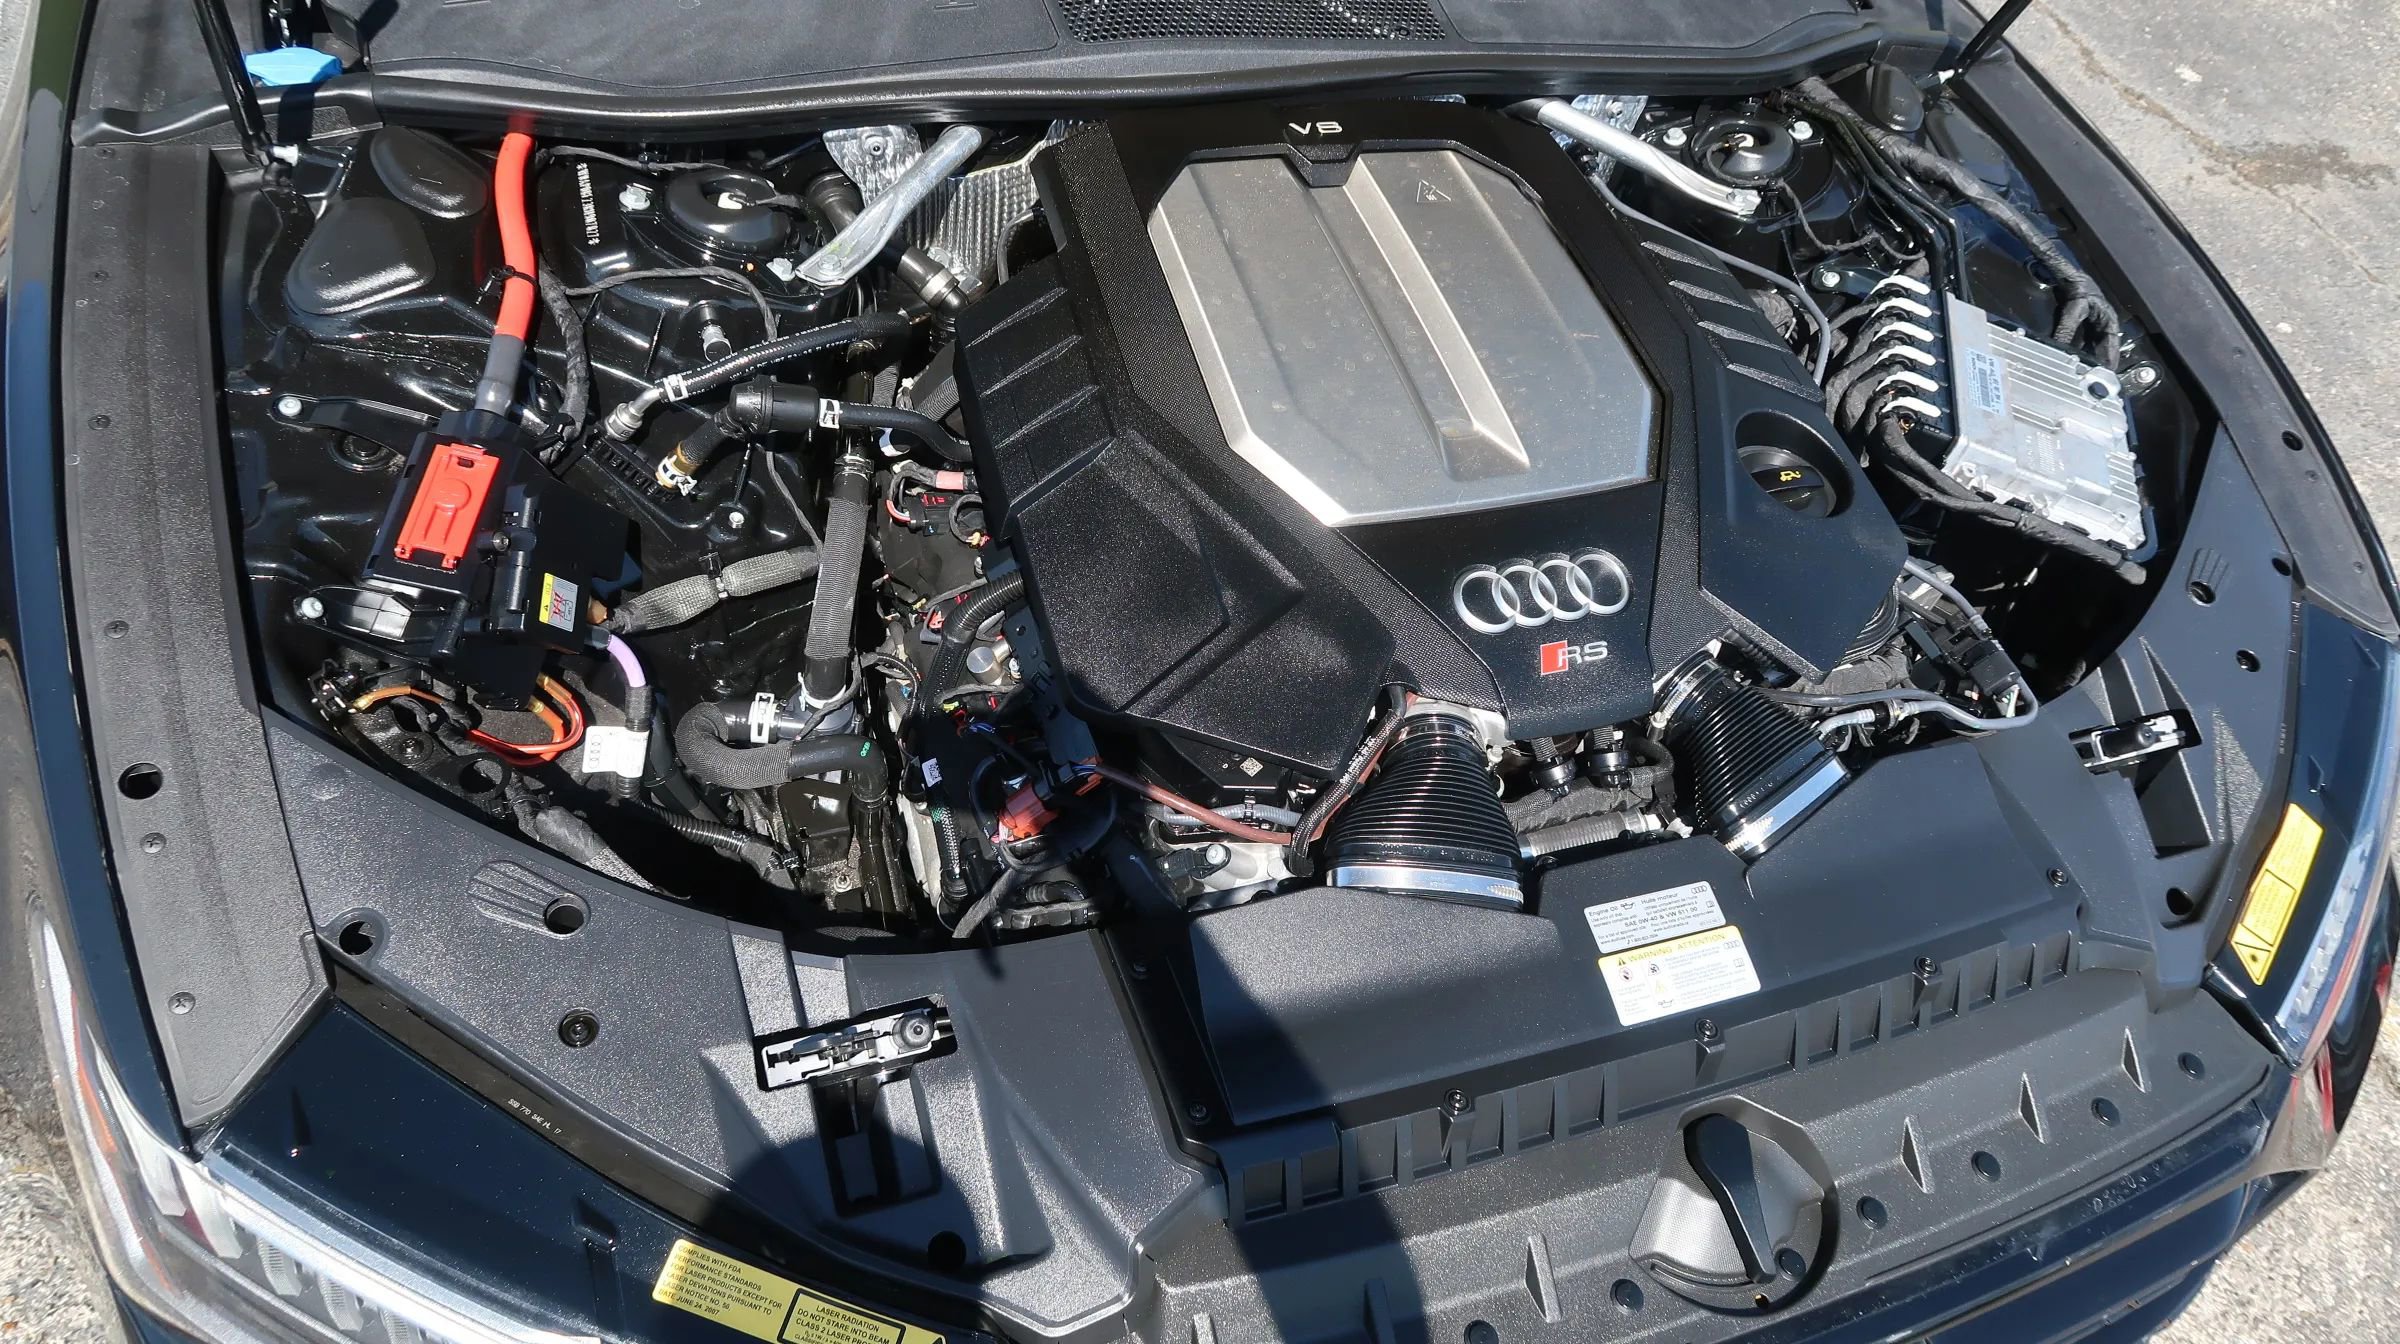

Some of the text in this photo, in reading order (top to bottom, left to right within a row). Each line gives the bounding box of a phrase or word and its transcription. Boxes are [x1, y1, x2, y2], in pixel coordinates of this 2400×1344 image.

[1288, 122, 1342, 134] V8
[1558, 641, 1608, 668] RS
[1589, 908, 1609, 917] Engine
[1630, 946, 1672, 962] WARNING
[1677, 932, 1726, 950] ATTENTION
[674, 1254, 762, 1291] PERFORMANCE STANDARDS
[679, 1245, 741, 1274] COMPLIES WITH FDA
[662, 1280, 684, 1293] LASER
[684, 1288, 710, 1301] NOTICE
[666, 1272, 772, 1316] LASER DEVIATIONS PURSUANT TO
[670, 1263, 782, 1310] FOR LASER PRODUCTS EXCEPT FOR
[676, 1296, 692, 1308] JUNE
[704, 1306, 720, 1316] 2007
[816, 1306, 880, 1332] LASER RADIATION
[796, 1318, 820, 1331] CLASS
[826, 1329, 850, 1342] LASER
[798, 1308, 808, 1318] DO
[810, 1313, 824, 1324] NOT
[826, 1319, 850, 1332] STARE
[850, 1327, 868, 1338] INTO
[868, 1334, 890, 1344] BEAM
